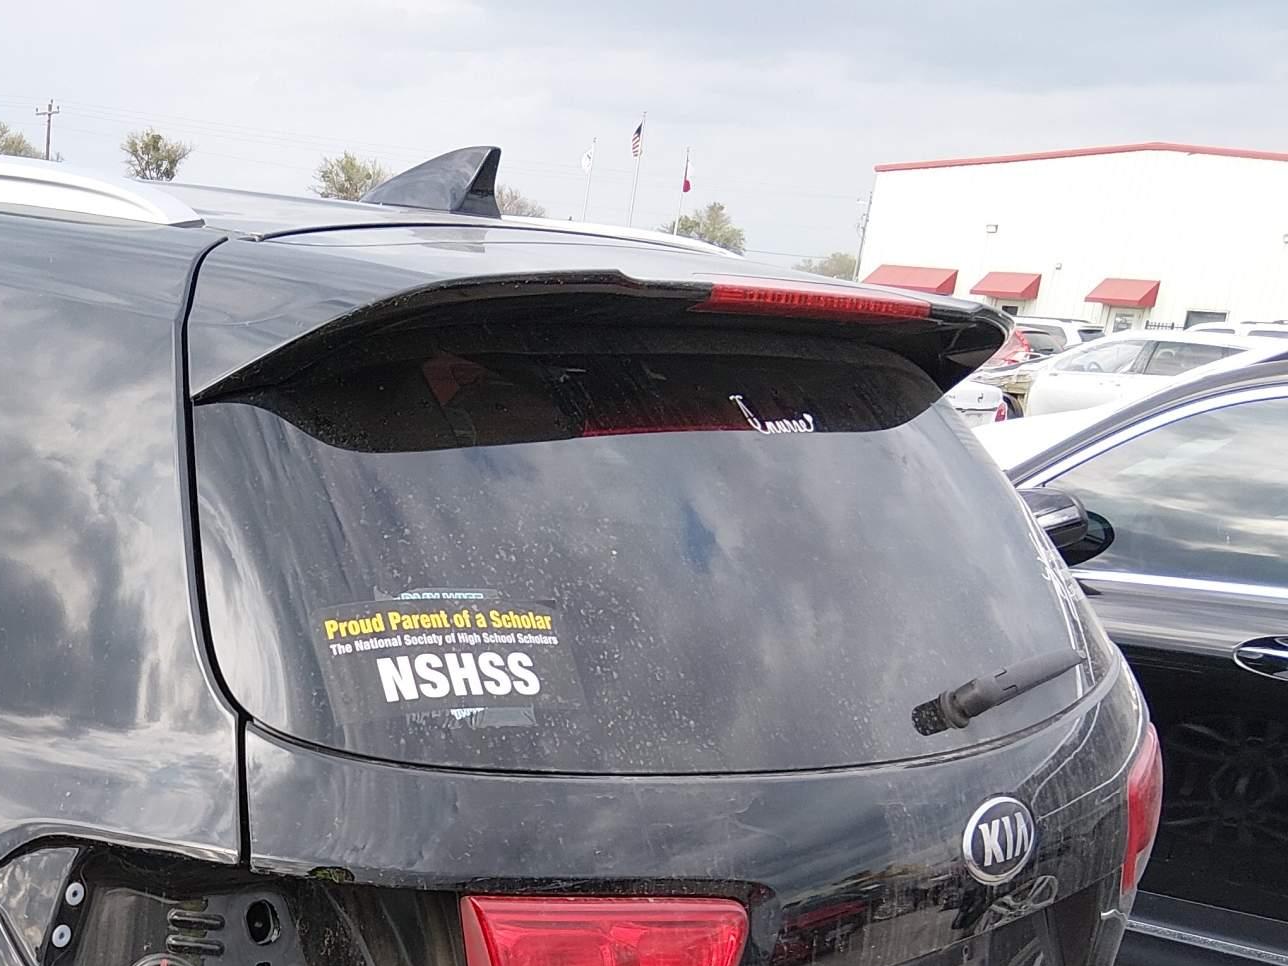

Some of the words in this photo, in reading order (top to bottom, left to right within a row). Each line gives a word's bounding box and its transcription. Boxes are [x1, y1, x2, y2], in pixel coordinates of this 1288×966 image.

[324, 613, 385, 640] Proud
[388, 610, 450, 630] Parent
[453, 610, 471, 628] of
[475, 613, 487, 628] a
[491, 609, 552, 630] Scholar
[329, 643, 353, 656] The
[354, 635, 402, 651] National
[403, 633, 443, 647] Society
[445, 632, 457, 643] of
[458, 632, 481, 646] High
[483, 632, 516, 644] School
[518, 633, 559, 646] Scholars
[376, 652, 541, 703] NSHSS
[978, 811, 1029, 867] KIA
